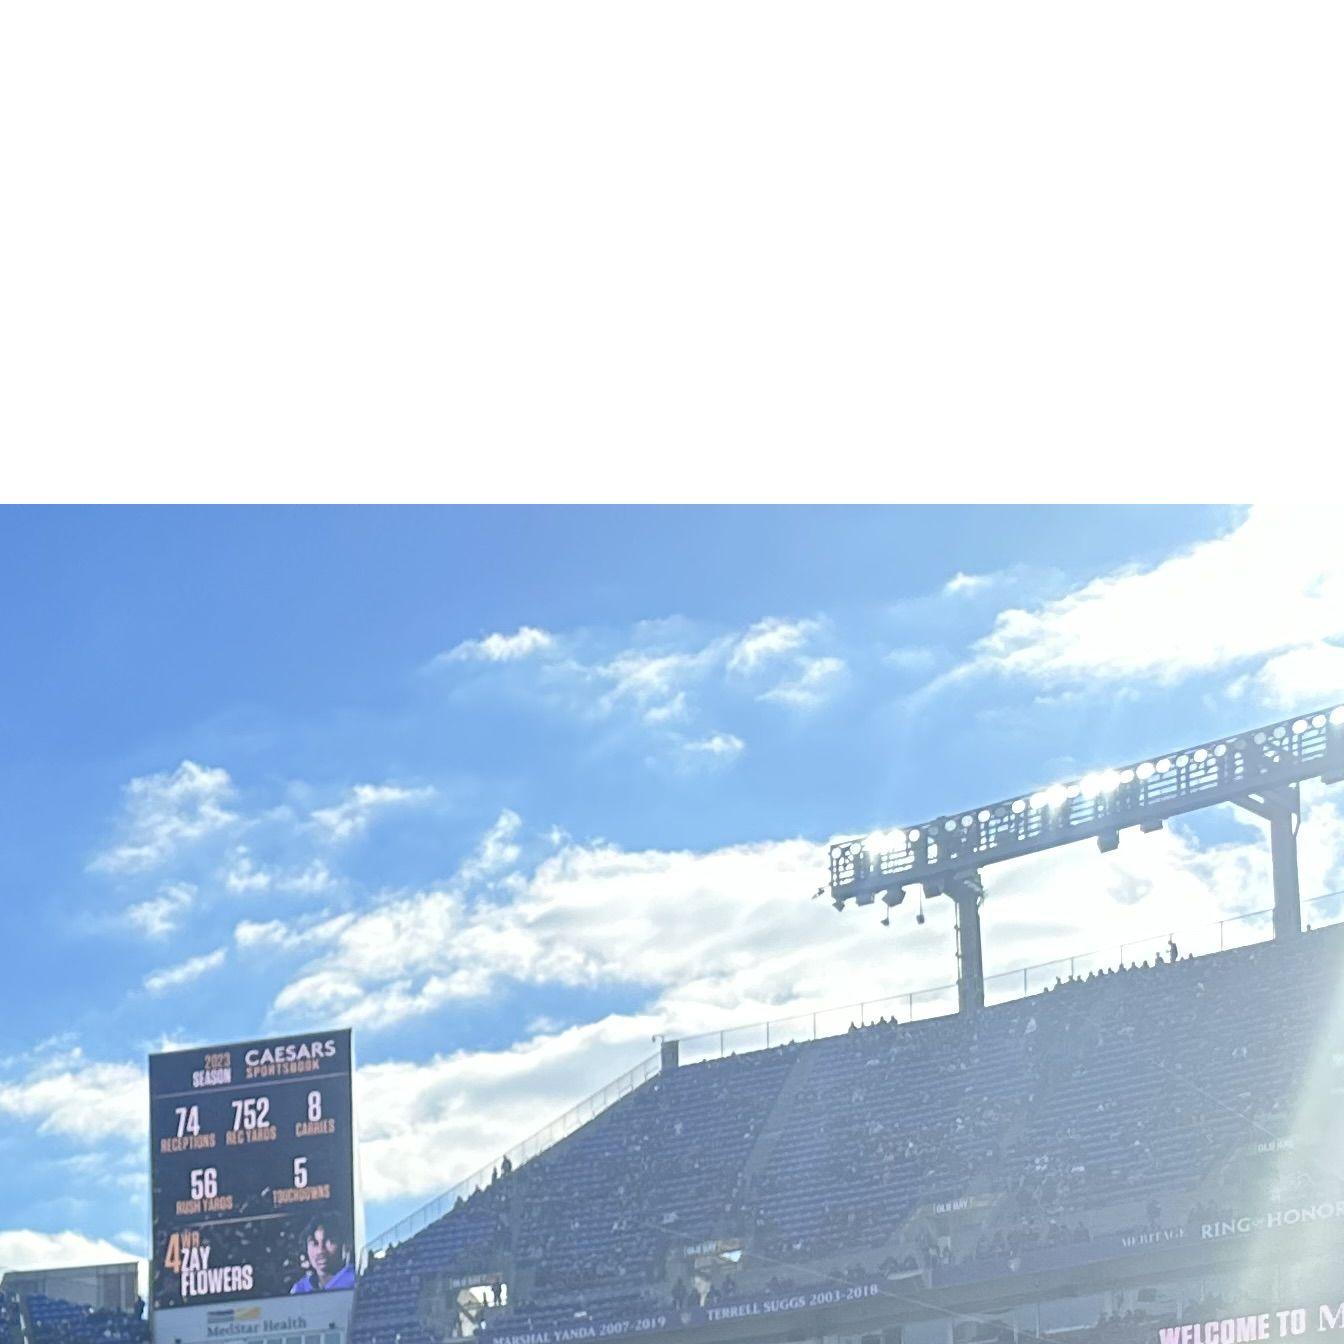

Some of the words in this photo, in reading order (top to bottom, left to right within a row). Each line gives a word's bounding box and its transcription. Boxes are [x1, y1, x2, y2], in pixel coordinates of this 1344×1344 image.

[245, 1040, 336, 1066] CAESARS
[193, 1068, 231, 1088] SEASON
[246, 1059, 320, 1079] SPORTSBOOK
[175, 1105, 200, 1138] 74
[232, 1097, 271, 1131] 752
[307, 1090, 322, 1122] 8
[226, 1130, 244, 1145] REC
[245, 1125, 277, 1143] YARDS
[295, 1119, 336, 1137] CARRIES
[161, 1133, 216, 1153] RECEPTIONS
[190, 1168, 218, 1200] 56
[293, 1157, 308, 1188] 5
[176, 1199, 201, 1216] RUSH
[202, 1195, 233, 1212] YARDS
[273, 1184, 330, 1206] TOUCHDOWNS
[1201, 1217, 1251, 1240] RING
[1266, 1201, 1344, 1228] HONOR
[181, 1230, 200, 1247] WR
[165, 1232, 181, 1274] 4
[181, 1246, 210, 1272] ZAY
[181, 1265, 253, 1297] FLOWERS
[707, 1304, 760, 1321] TERRELL
[763, 1295, 806, 1312] SUGGS
[809, 1283, 879, 1306] 2003-2018
[208, 1321, 261, 1337] MedStar
[264, 1316, 307, 1333] Health
[553, 1327, 596, 1342] YANDA
[599, 1316, 667, 1337] 2007-2019
[1276, 1308, 1306, 1337] TO
